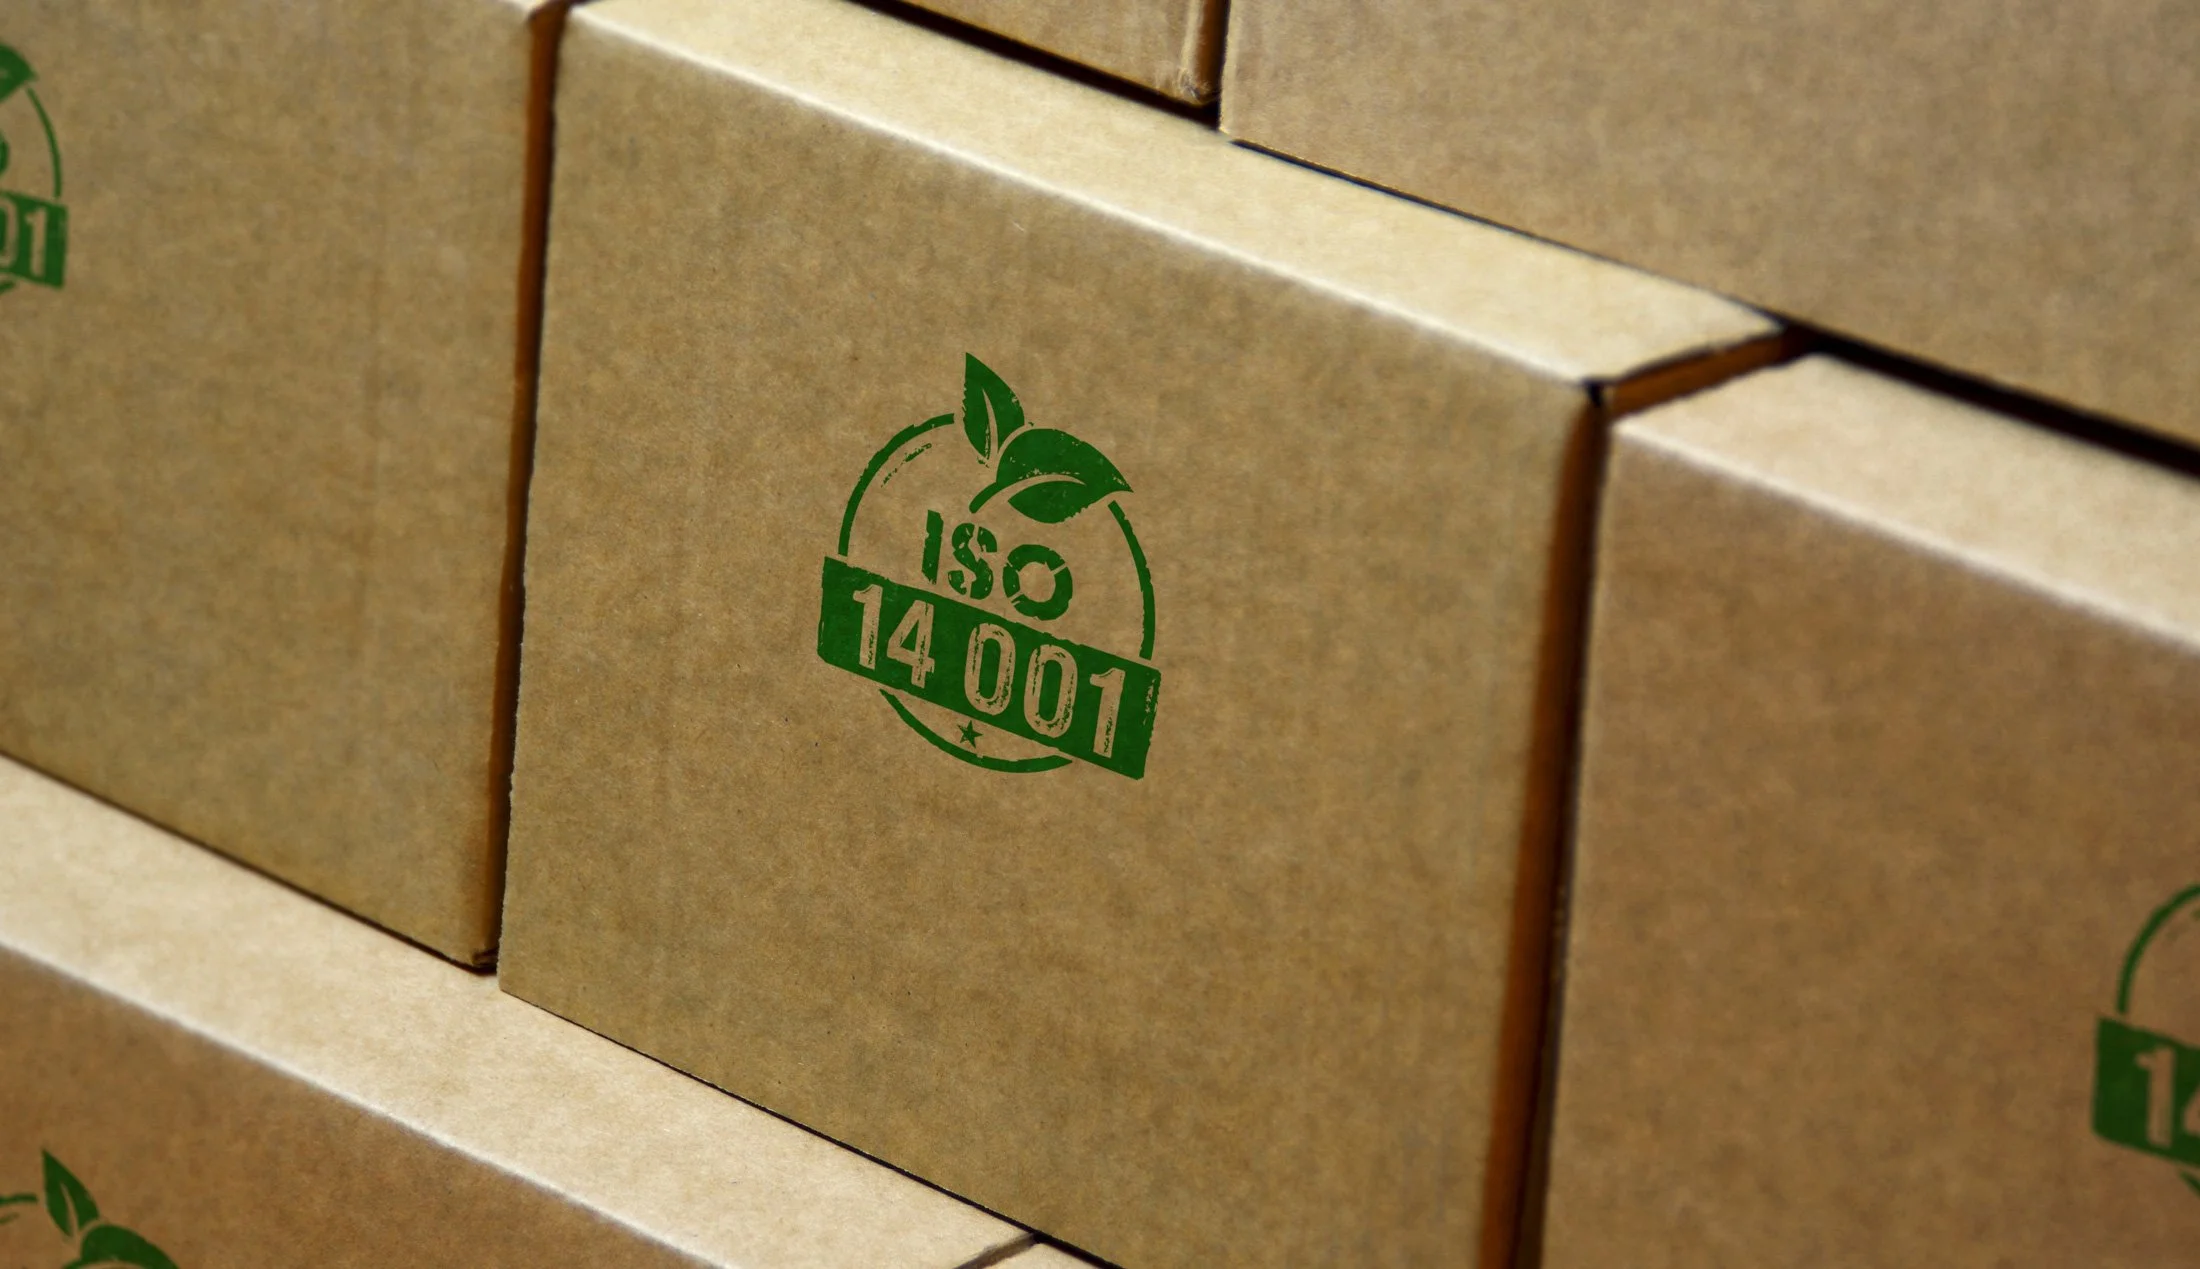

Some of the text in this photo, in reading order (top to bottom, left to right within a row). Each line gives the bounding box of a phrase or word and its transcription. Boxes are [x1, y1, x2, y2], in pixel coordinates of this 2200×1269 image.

[921, 509, 1074, 622] ISO
[851, 584, 1127, 759] 14 001
[2135, 1047, 2200, 1148] 1
